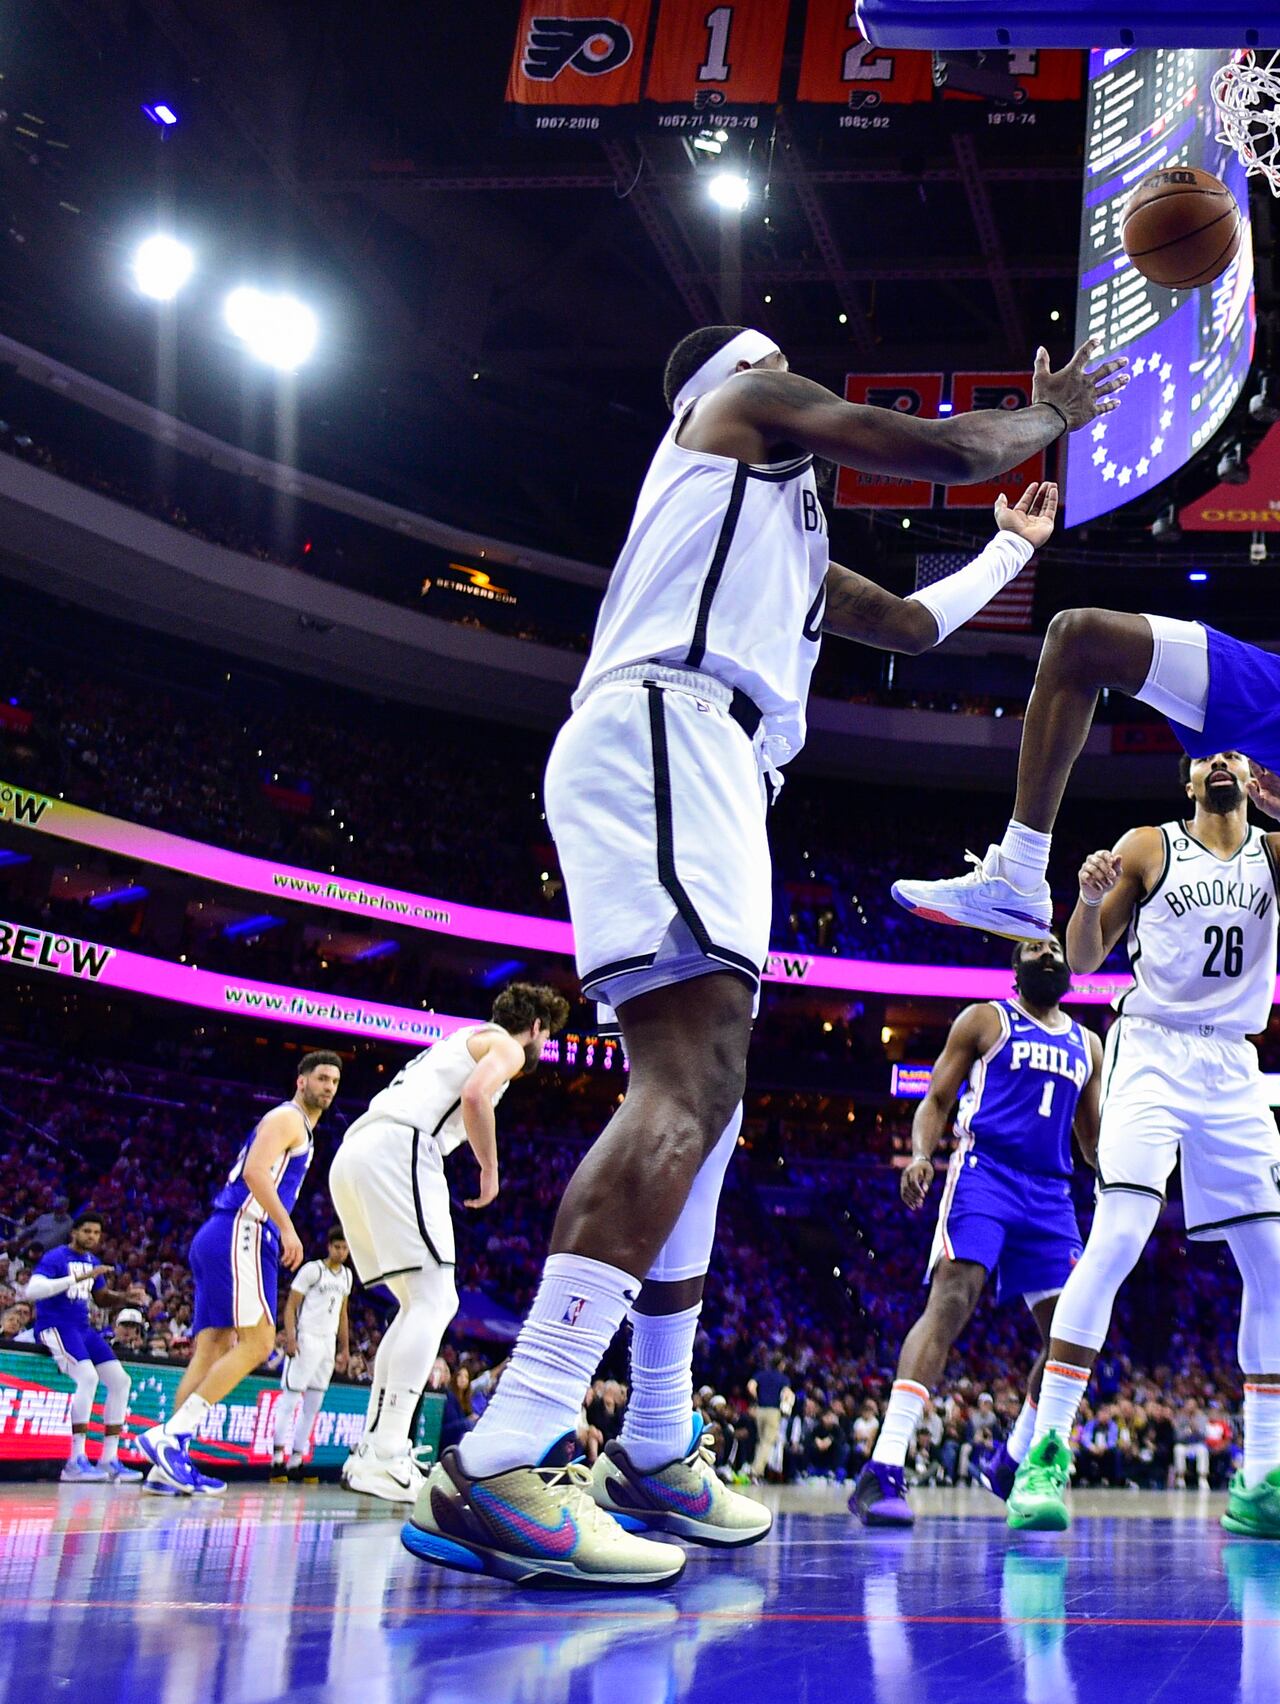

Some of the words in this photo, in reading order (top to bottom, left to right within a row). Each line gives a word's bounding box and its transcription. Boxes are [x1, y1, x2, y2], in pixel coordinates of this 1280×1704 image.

[700, 8, 730, 81] 1
[273, 874, 451, 924] www.fivebelow.com
[1164, 879, 1273, 921] BROOKLYN
[1202, 925, 1244, 978] 26
[224, 986, 444, 1039] www.fivebelow.com
[1009, 1040, 1087, 1092] PHILA
[1037, 1080, 1056, 1118] 1
